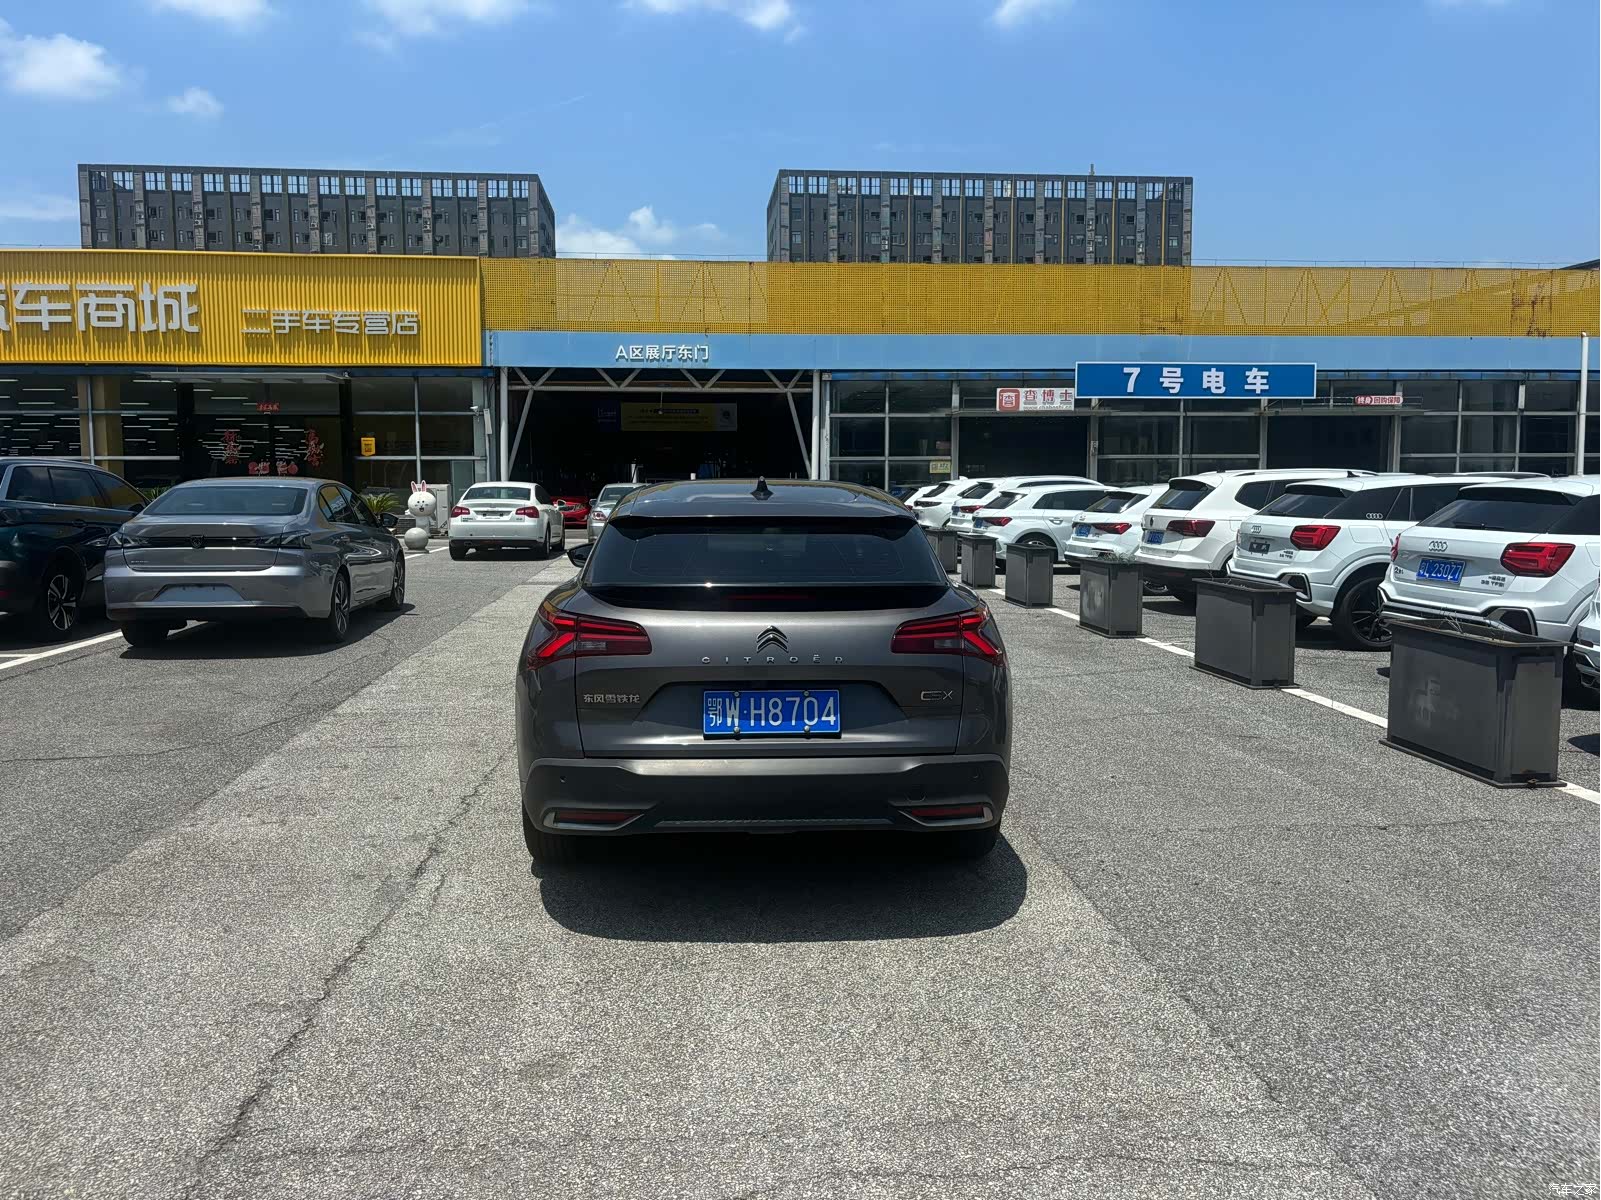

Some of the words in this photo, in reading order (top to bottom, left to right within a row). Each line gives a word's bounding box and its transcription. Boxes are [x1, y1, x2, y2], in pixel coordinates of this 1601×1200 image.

[0, 281, 200, 333] 车商城
[241, 308, 419, 335] 二手车专营店
[615, 344, 709, 361] A区展厅东门
[1122, 366, 1270, 394] 7号电车
[1023, 389, 1073, 404] 查博士
[701, 653, 843, 664] CITROËN
[583, 694, 640, 704] 东风雪铁龙
